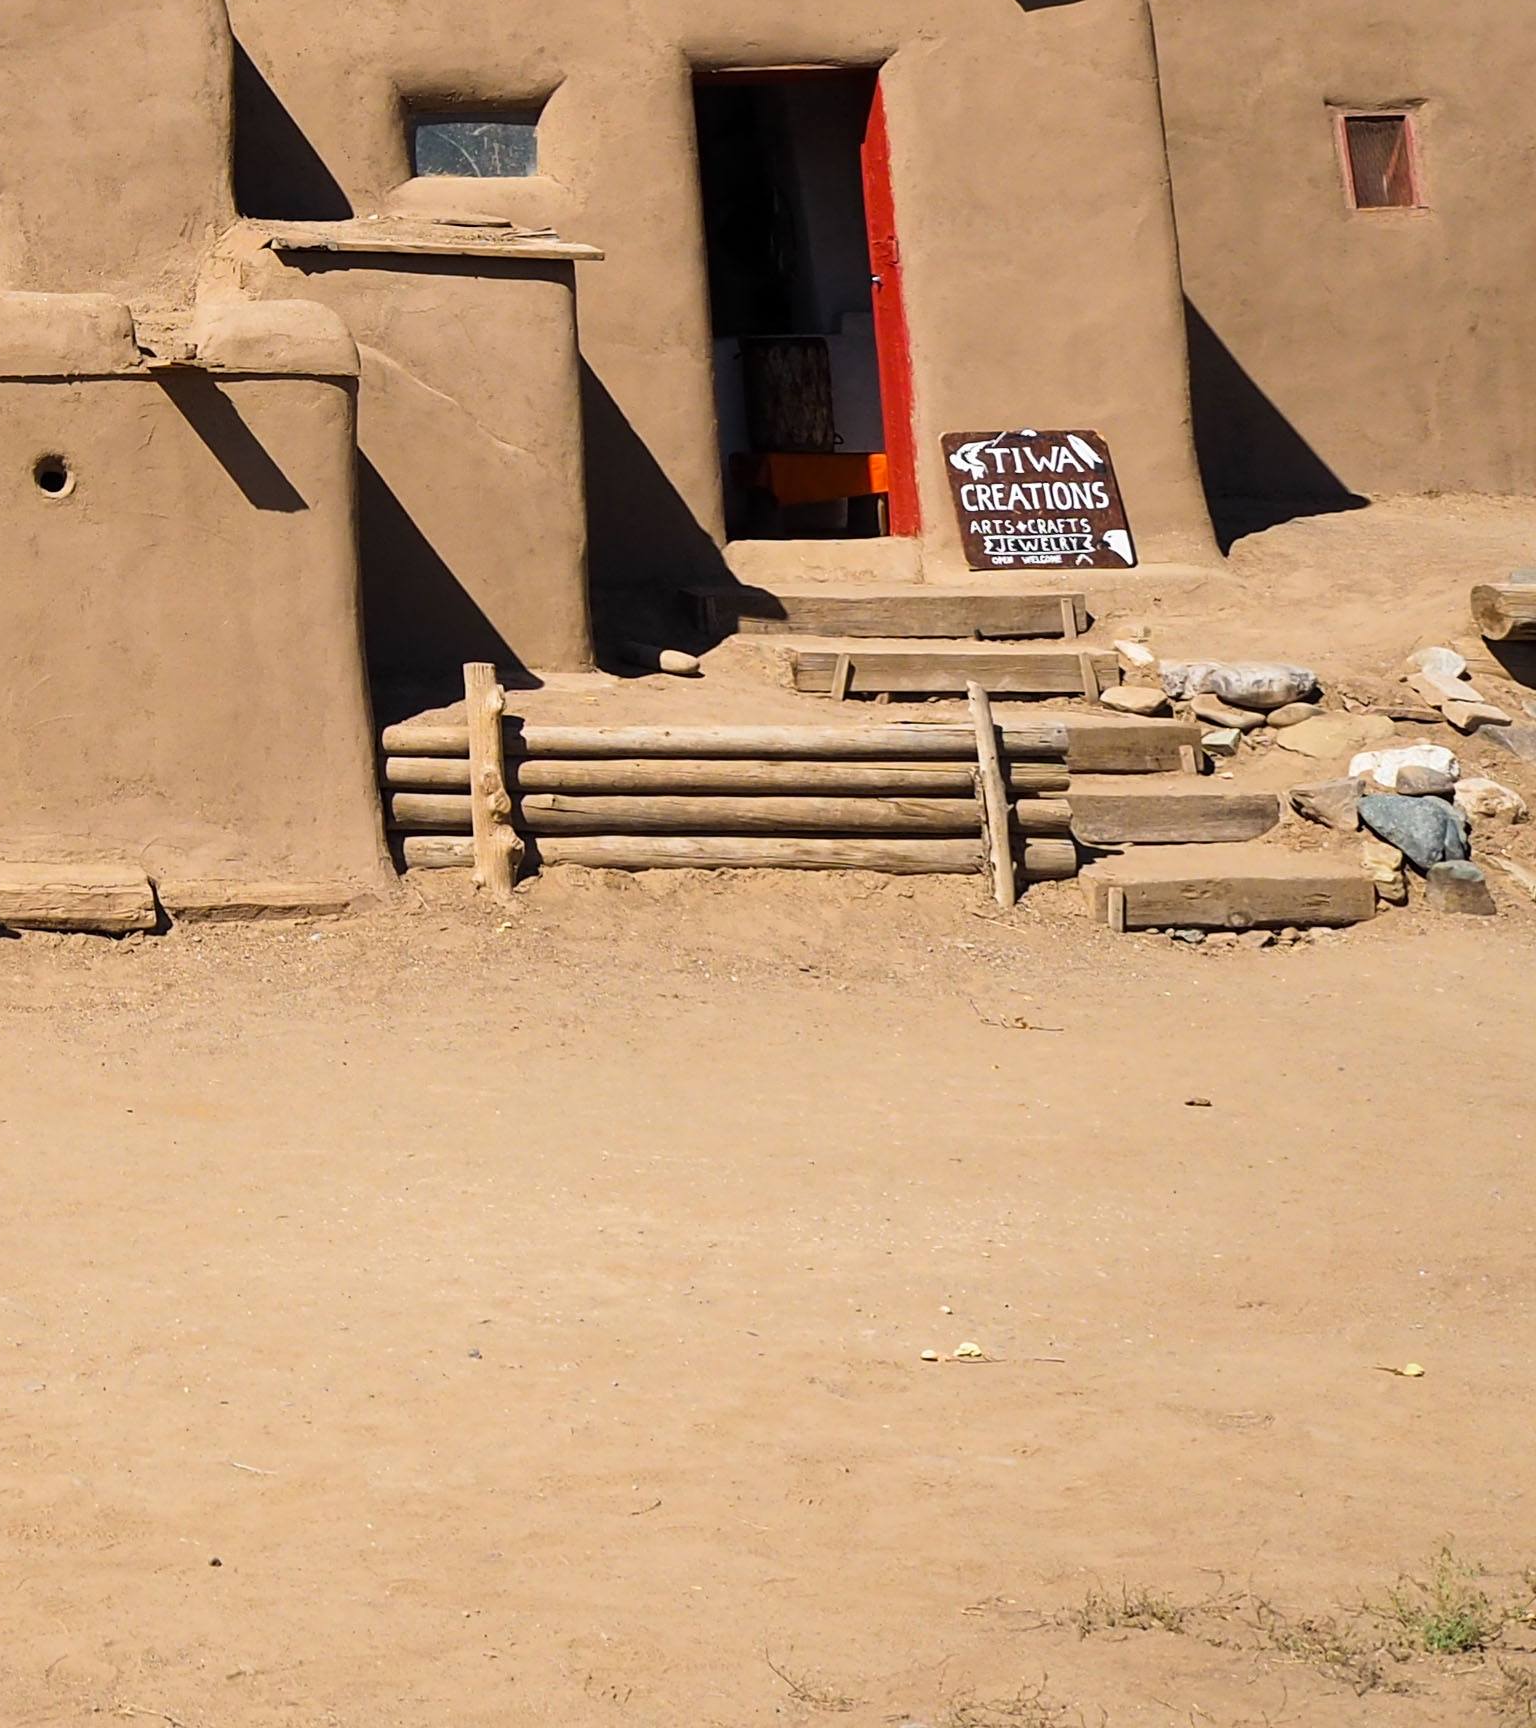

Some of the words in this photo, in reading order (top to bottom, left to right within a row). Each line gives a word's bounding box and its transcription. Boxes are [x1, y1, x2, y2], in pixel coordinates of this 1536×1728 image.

[985, 446, 1085, 474] TIWA
[960, 482, 1109, 512] CREATIONS
[996, 537, 1078, 552] JEWELRY
[1021, 555, 1063, 564] WELCOME
